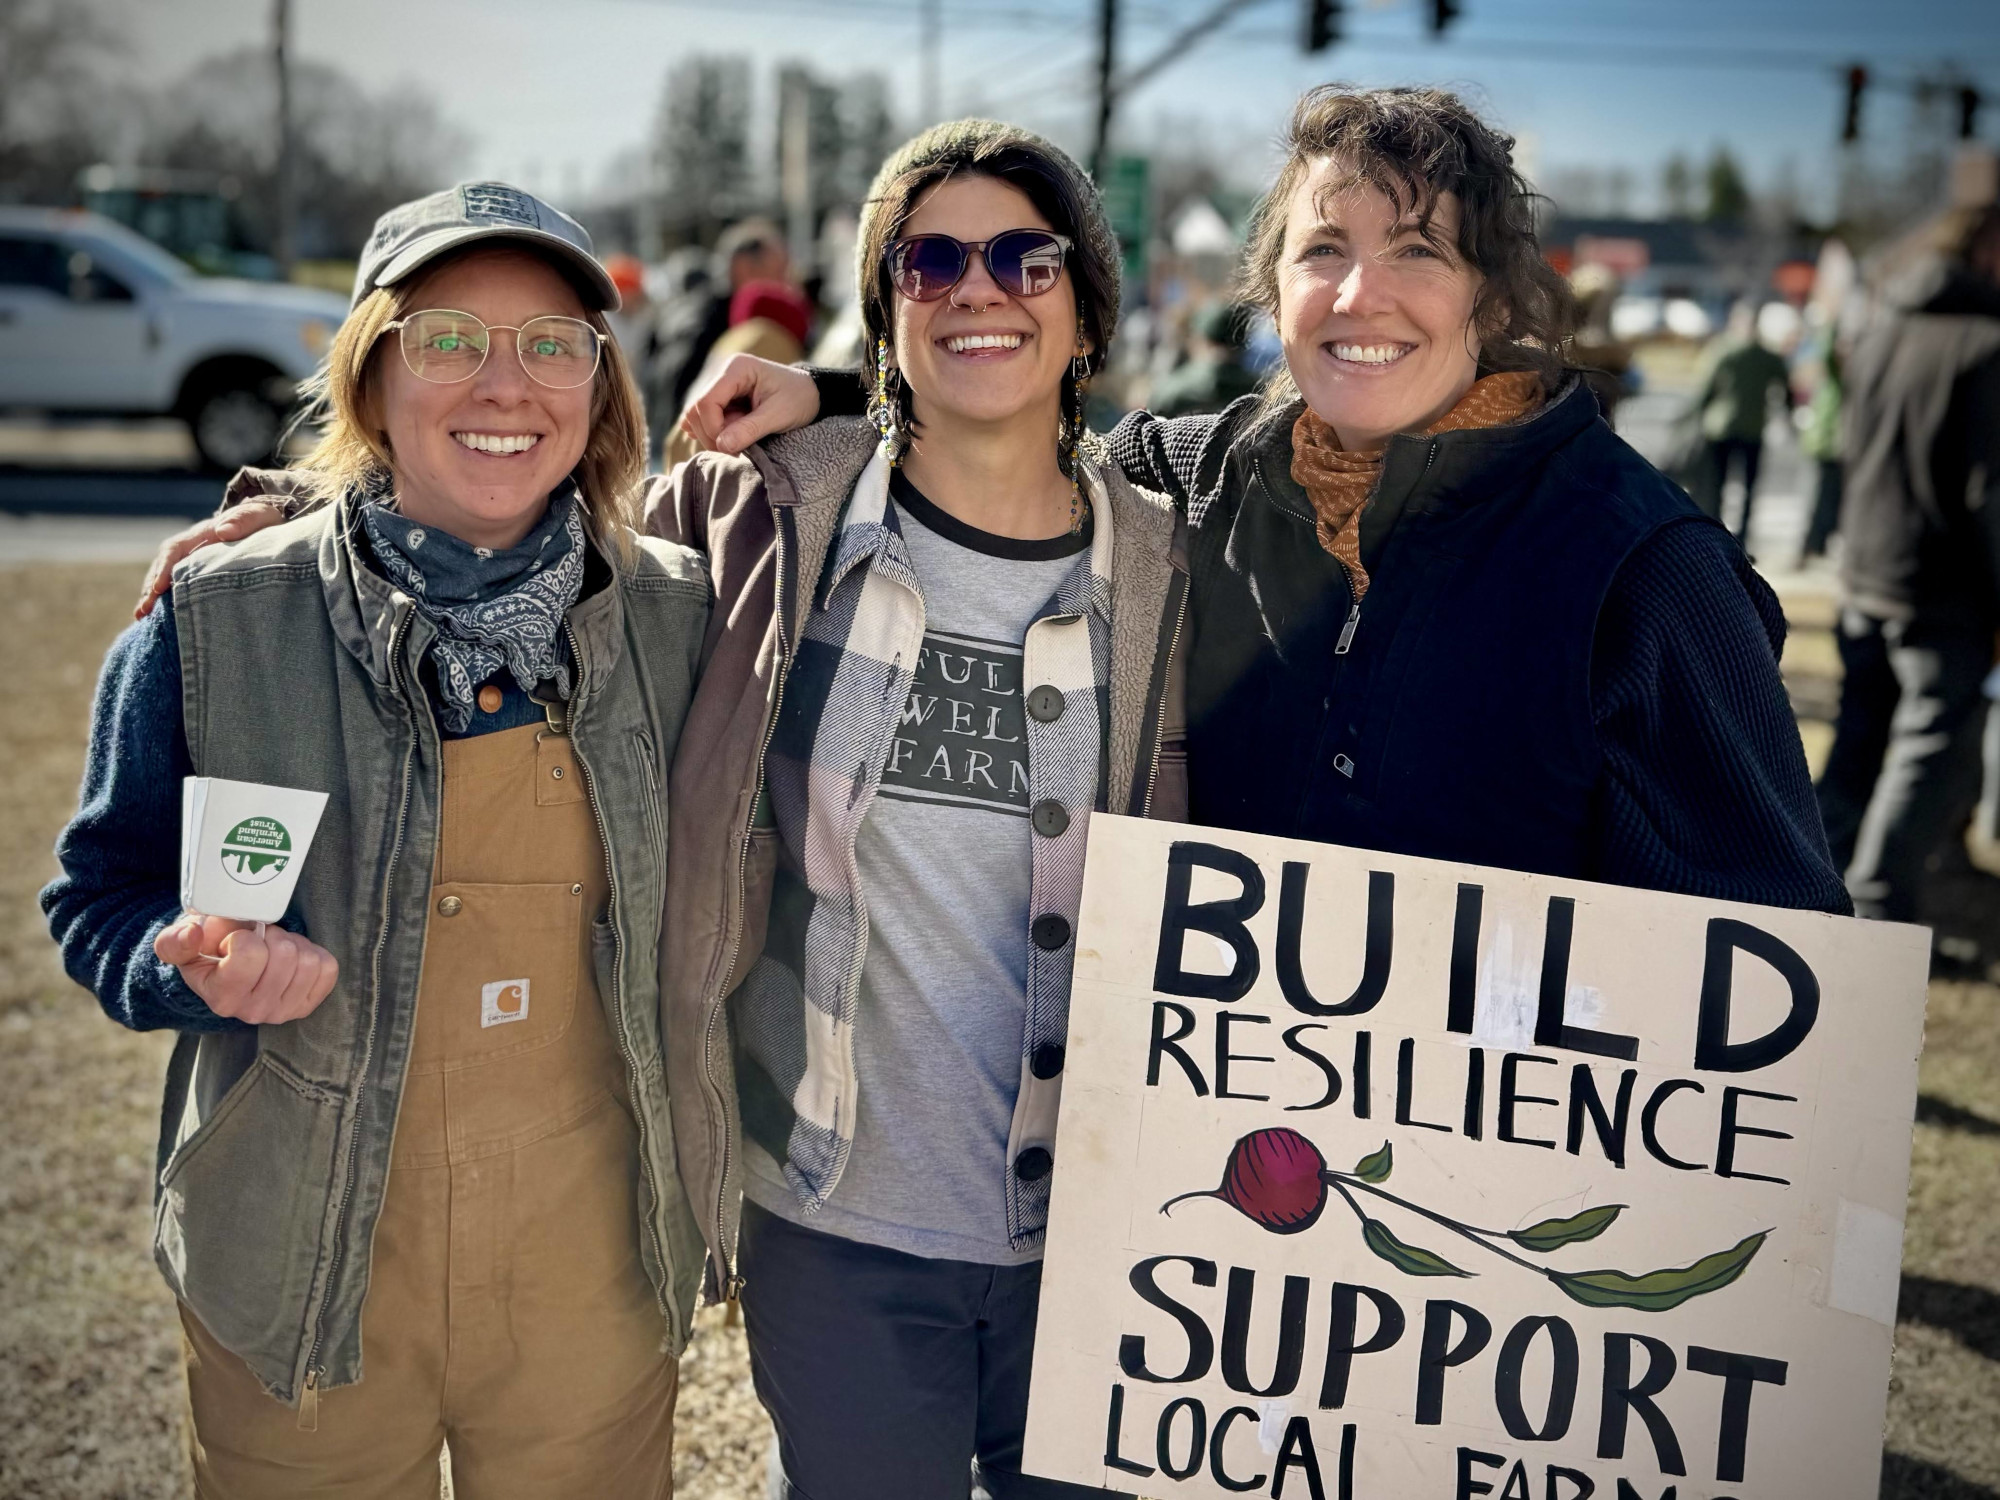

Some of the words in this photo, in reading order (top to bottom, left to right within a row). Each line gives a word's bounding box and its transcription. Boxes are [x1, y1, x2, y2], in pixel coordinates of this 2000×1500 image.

[912, 647, 1024, 697] UL
[901, 693, 1028, 745] WEL
[236, 834, 283, 848] American
[237, 826, 285, 840] Farmland
[250, 819, 277, 830] Trust
[1153, 841, 1820, 1072] BUILD
[1147, 1001, 1798, 1185] RESILIENCE
[1119, 1255, 1788, 1483] SUPPORT
